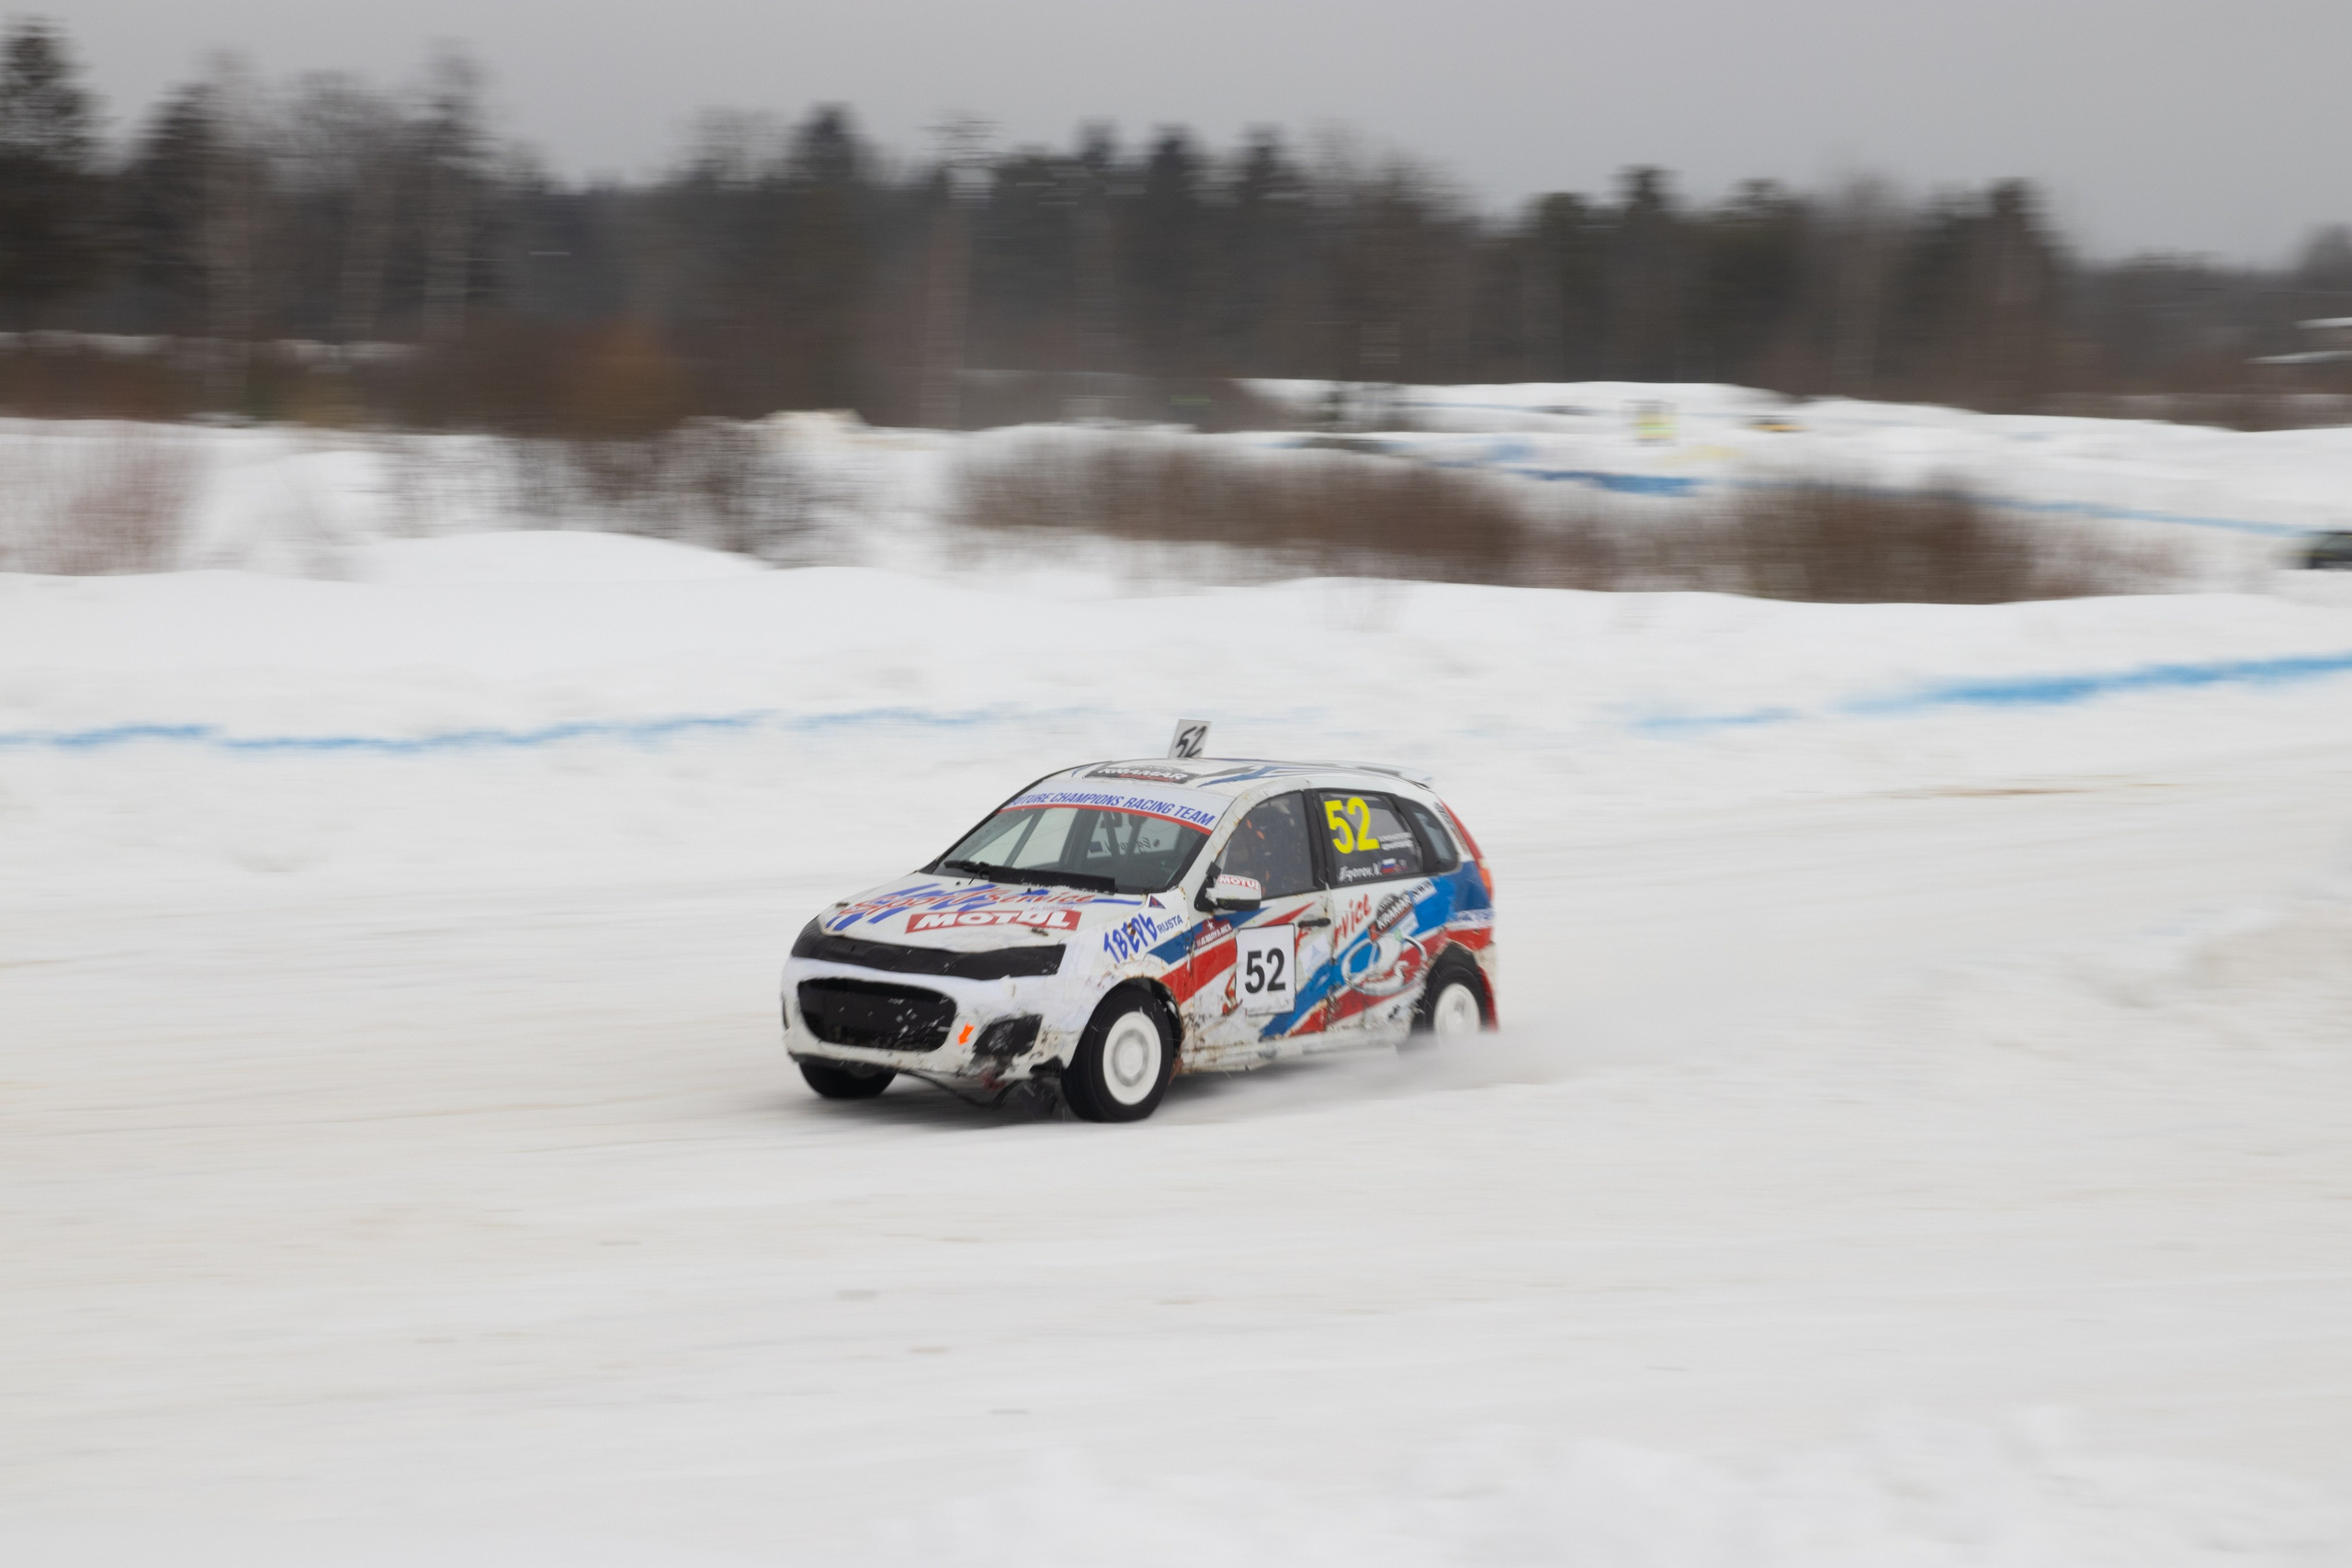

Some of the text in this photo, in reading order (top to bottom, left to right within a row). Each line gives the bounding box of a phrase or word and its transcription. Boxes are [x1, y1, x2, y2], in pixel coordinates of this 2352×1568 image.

[1175, 725, 1208, 758] 52
[1050, 792, 1125, 807] CHAMPIONS
[1123, 796, 1179, 815] RACING
[1175, 805, 1216, 826] TEAM
[1324, 796, 1380, 854] 52
[912, 910, 1071, 931] MOTUL
[1157, 914, 1183, 934] RUSTA
[1244, 948, 1286, 994] 52
